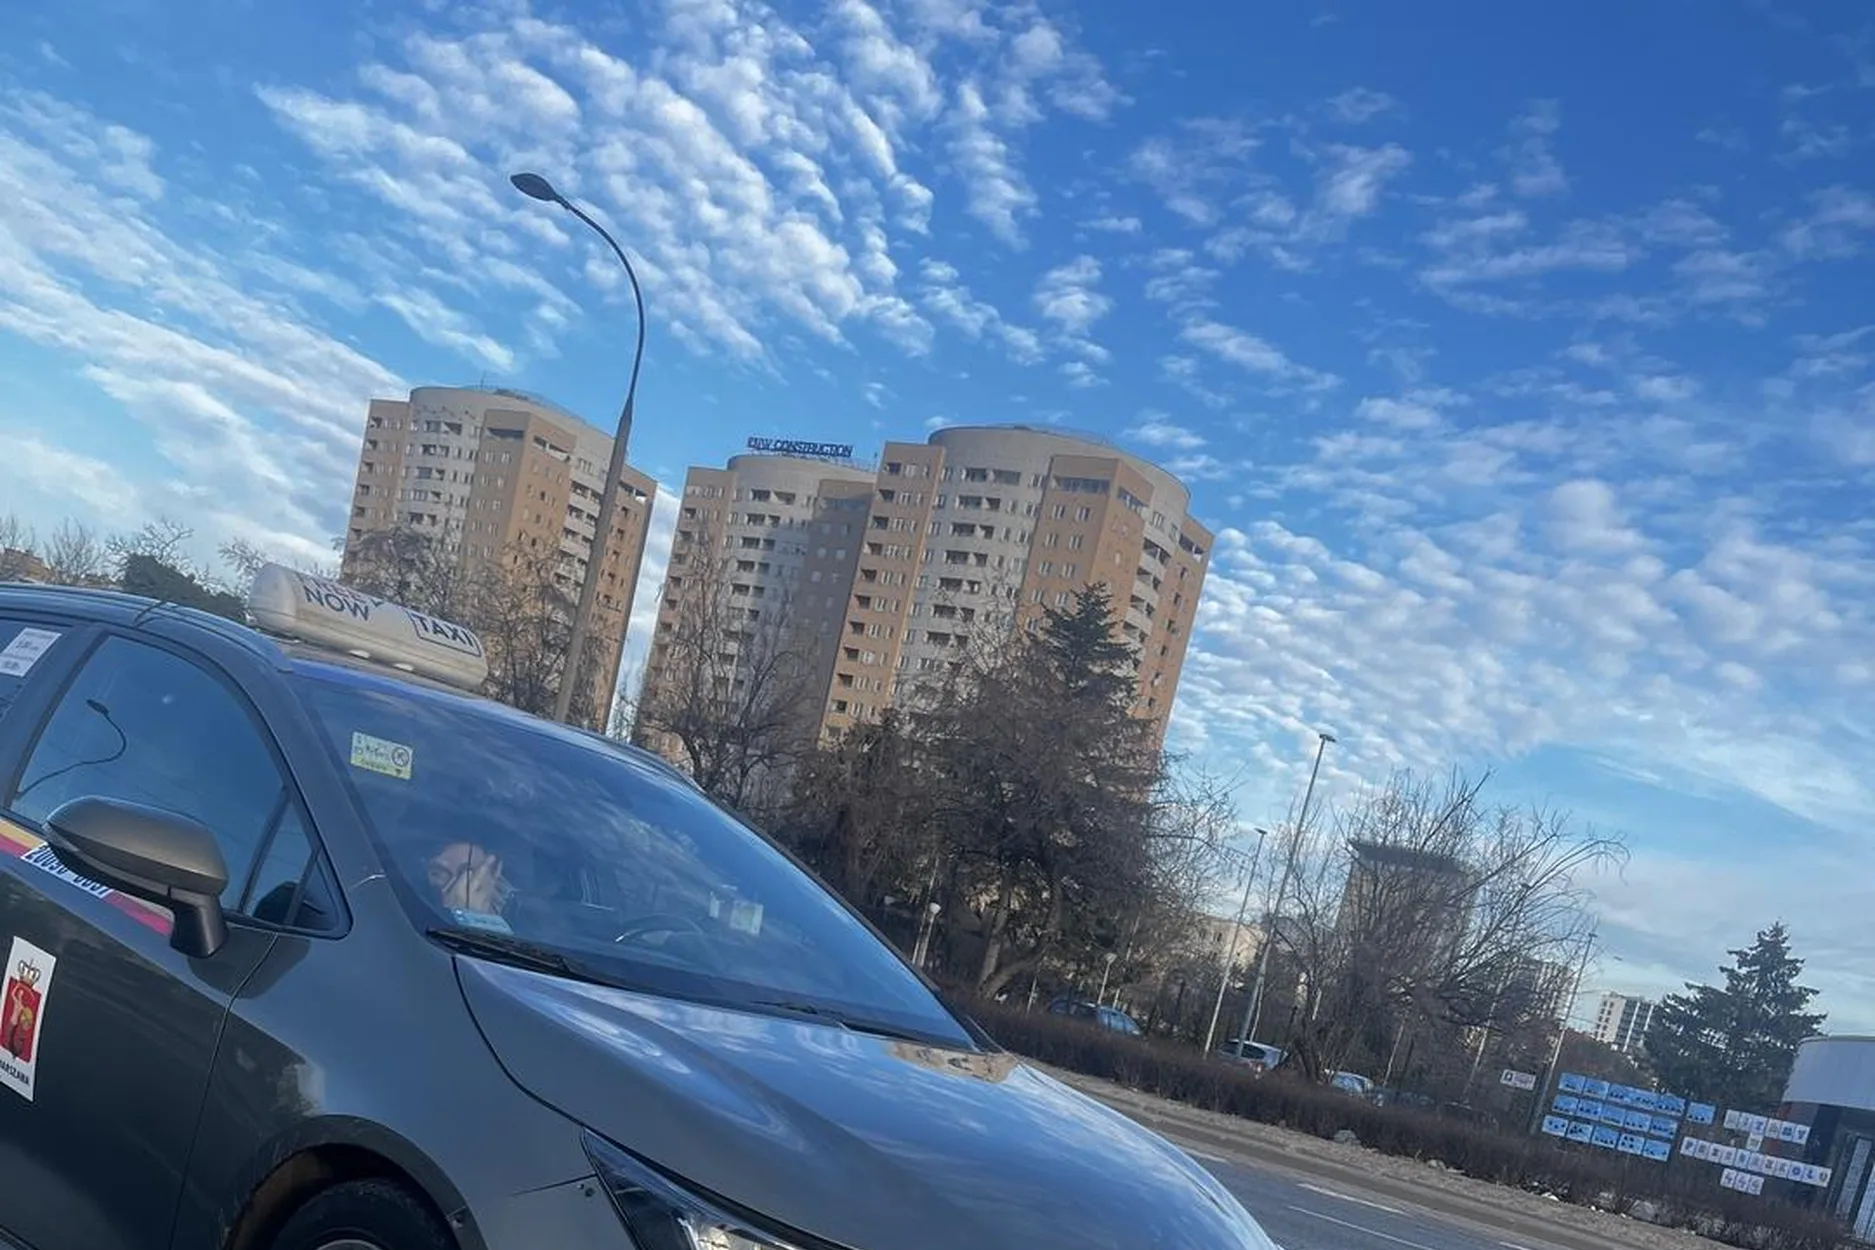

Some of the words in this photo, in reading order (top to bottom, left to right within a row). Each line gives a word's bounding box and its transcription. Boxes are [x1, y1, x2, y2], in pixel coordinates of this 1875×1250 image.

[775, 440, 853, 458] CONSTRUCTION
[304, 585, 369, 621] NOW
[412, 612, 474, 648] TAXI
